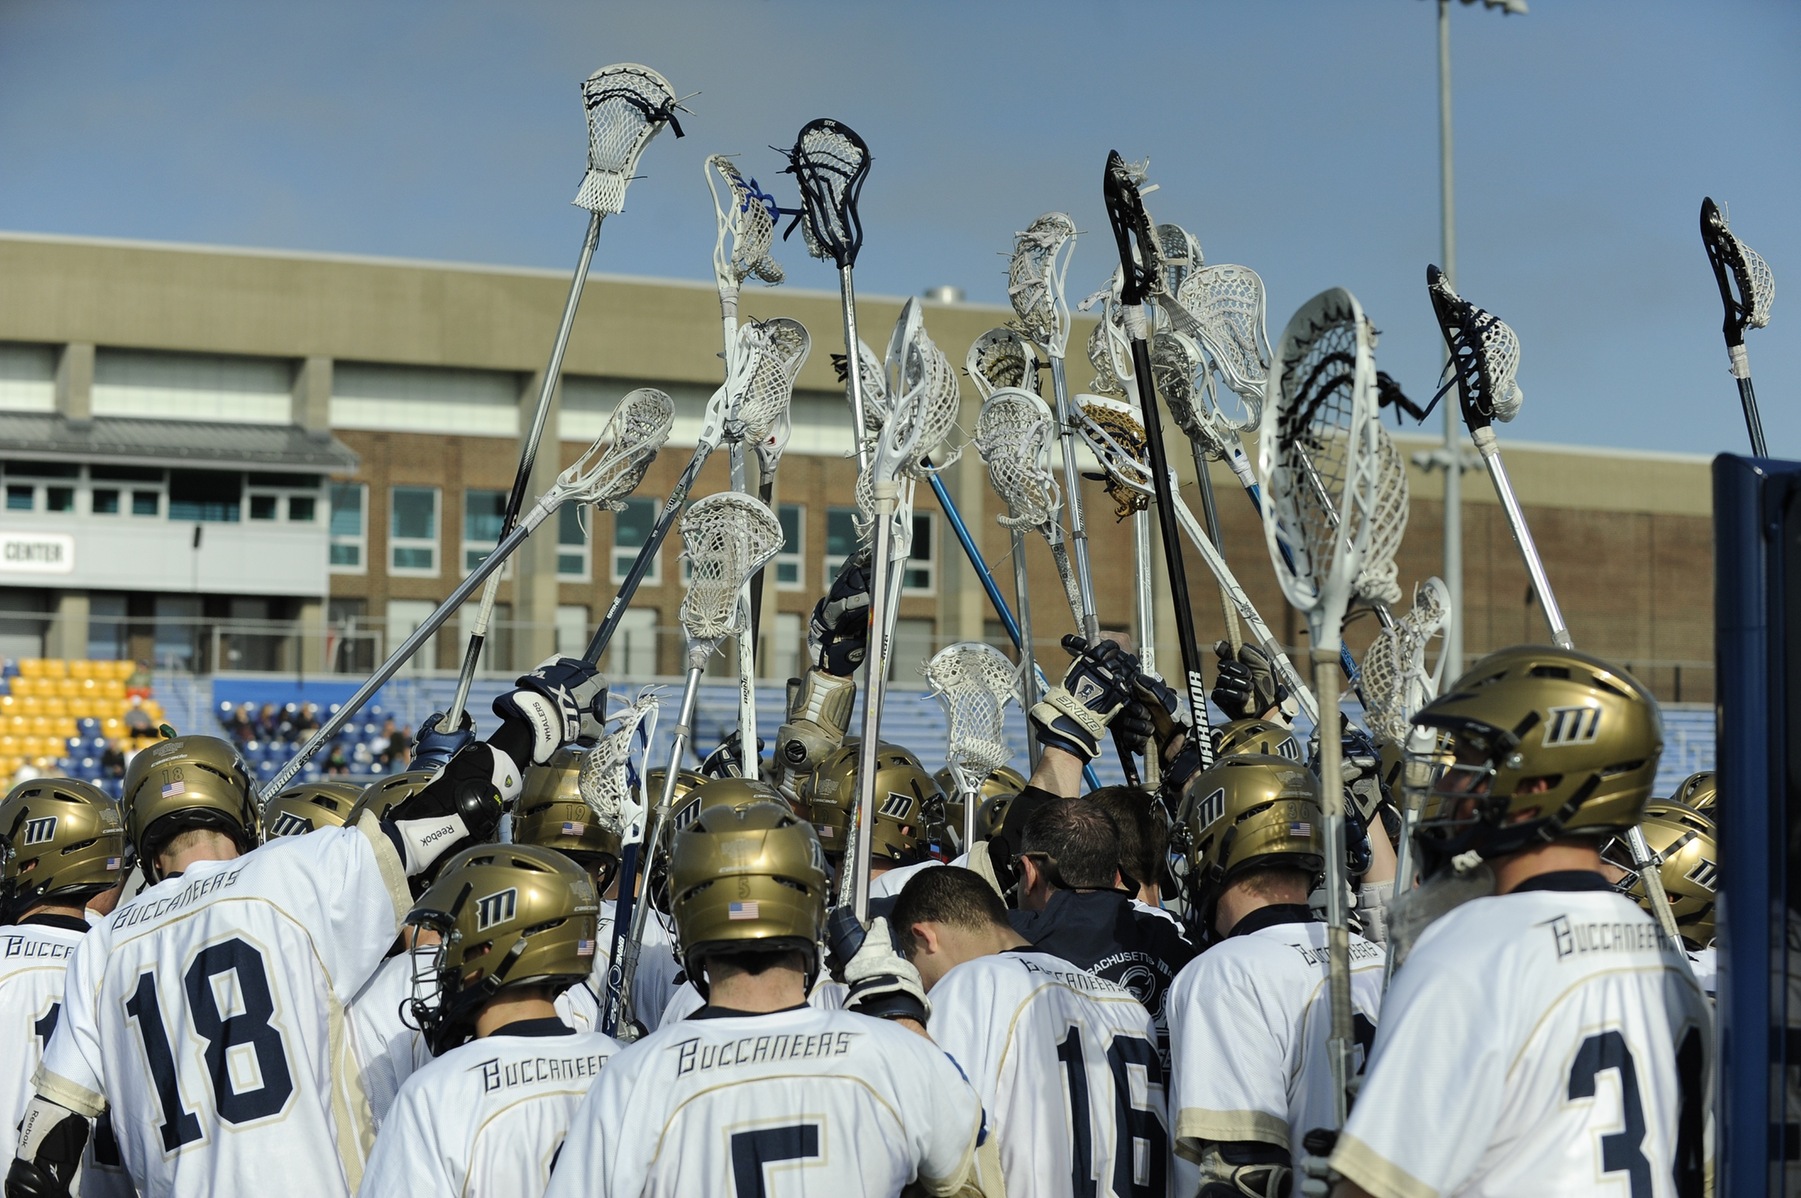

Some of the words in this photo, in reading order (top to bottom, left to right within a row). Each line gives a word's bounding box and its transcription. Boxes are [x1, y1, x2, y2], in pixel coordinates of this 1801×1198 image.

[823, 119, 837, 127] STX
[5, 541, 64, 562] CENTER
[532, 701, 552, 743] WHALERS
[1055, 695, 1101, 733] BRINE
[161, 766, 185, 784] 18
[565, 804, 586, 821] 19
[1287, 801, 1310, 819] 36
[419, 824, 455, 847] Reebok
[111, 862, 252, 935] BUCCANEERS
[738, 877, 751, 899] 5
[616, 935, 625, 967] BRINE
[126, 937, 293, 1153] 18
[664, 1032, 866, 1079] BUCCANEERS
[1055, 1025, 1168, 1198] 16
[21, 1109, 40, 1149] Reebok
